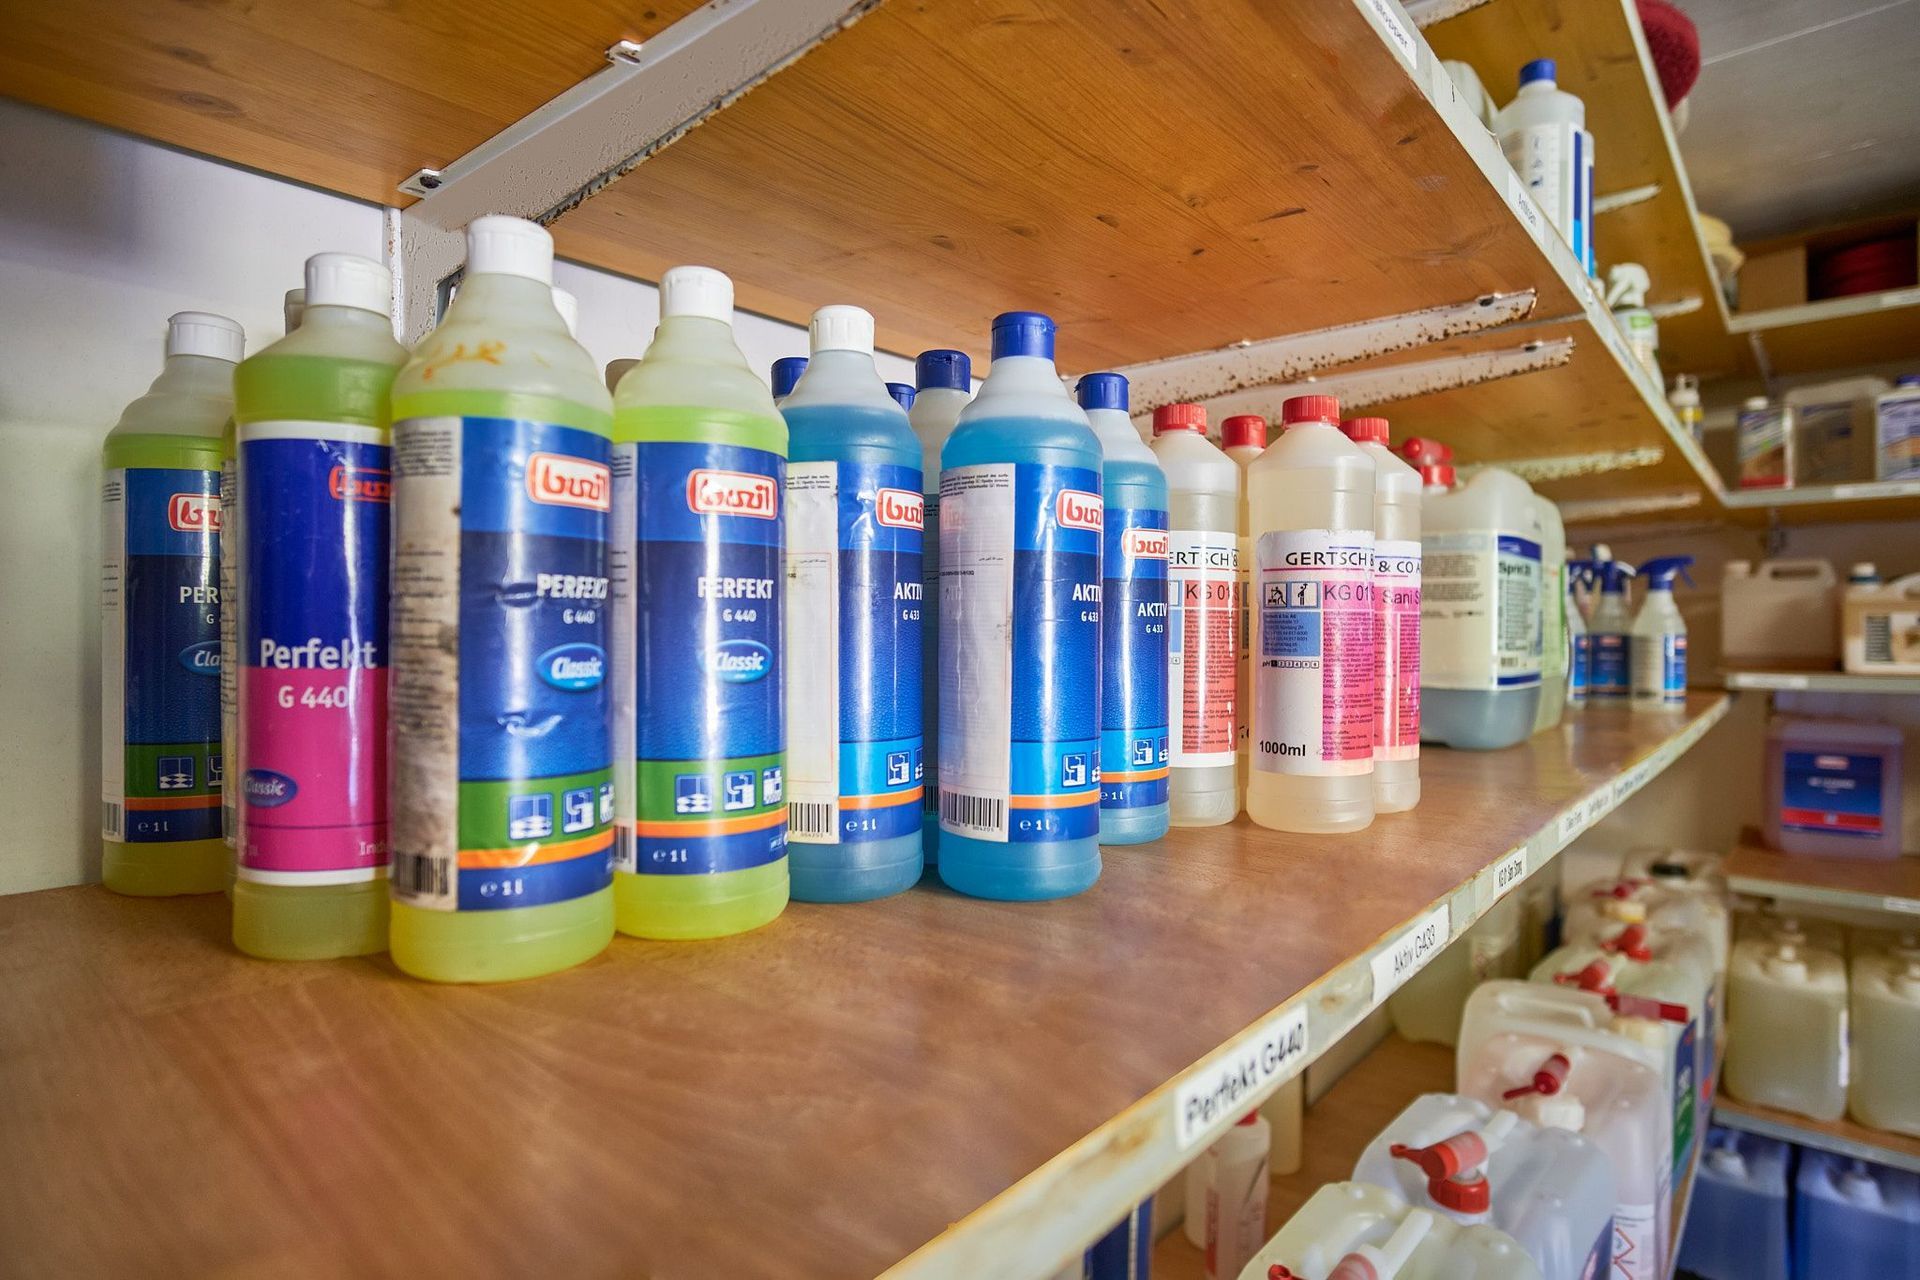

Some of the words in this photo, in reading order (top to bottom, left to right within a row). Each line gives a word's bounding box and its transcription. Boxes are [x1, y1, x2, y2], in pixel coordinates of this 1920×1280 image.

[1168, 551, 1229, 567] ERTSCH
[1286, 551, 1367, 567] GERTSCH
[1378, 560, 1391, 573] &
[1396, 560, 1414, 573] CO
[179, 586, 219, 604] PER
[536, 573, 609, 600] PERFEKT
[697, 577, 775, 600] PERFEKT
[1186, 583, 1212, 601] KG
[1324, 584, 1351, 601] KG
[1356, 584, 1369, 601] 01
[1382, 589, 1413, 605] Sani
[563, 608, 574, 624] G
[575, 608, 596, 624] 440
[723, 610, 732, 623] G
[735, 610, 757, 623] 440
[903, 610, 909, 621] G
[909, 609, 920, 621] 433
[1081, 611, 1087, 622] G
[1088, 611, 1099, 623] 433
[1138, 602, 1168, 618] AKTIV
[1146, 624, 1151, 634] G
[1152, 624, 1163, 634] 433
[194, 650, 221, 668] Cla
[260, 637, 378, 670] Perfekt
[551, 655, 603, 680] Classic
[714, 652, 765, 673] Classic
[278, 685, 294, 708] G
[301, 685, 351, 709] 440
[1259, 740, 1306, 756] 1000ml
[1393, 945, 1414, 977] Aktiv
[1414, 923, 1436, 959] G433
[1185, 1059, 1257, 1137] Perfekt
[1261, 1022, 1304, 1075] G440
